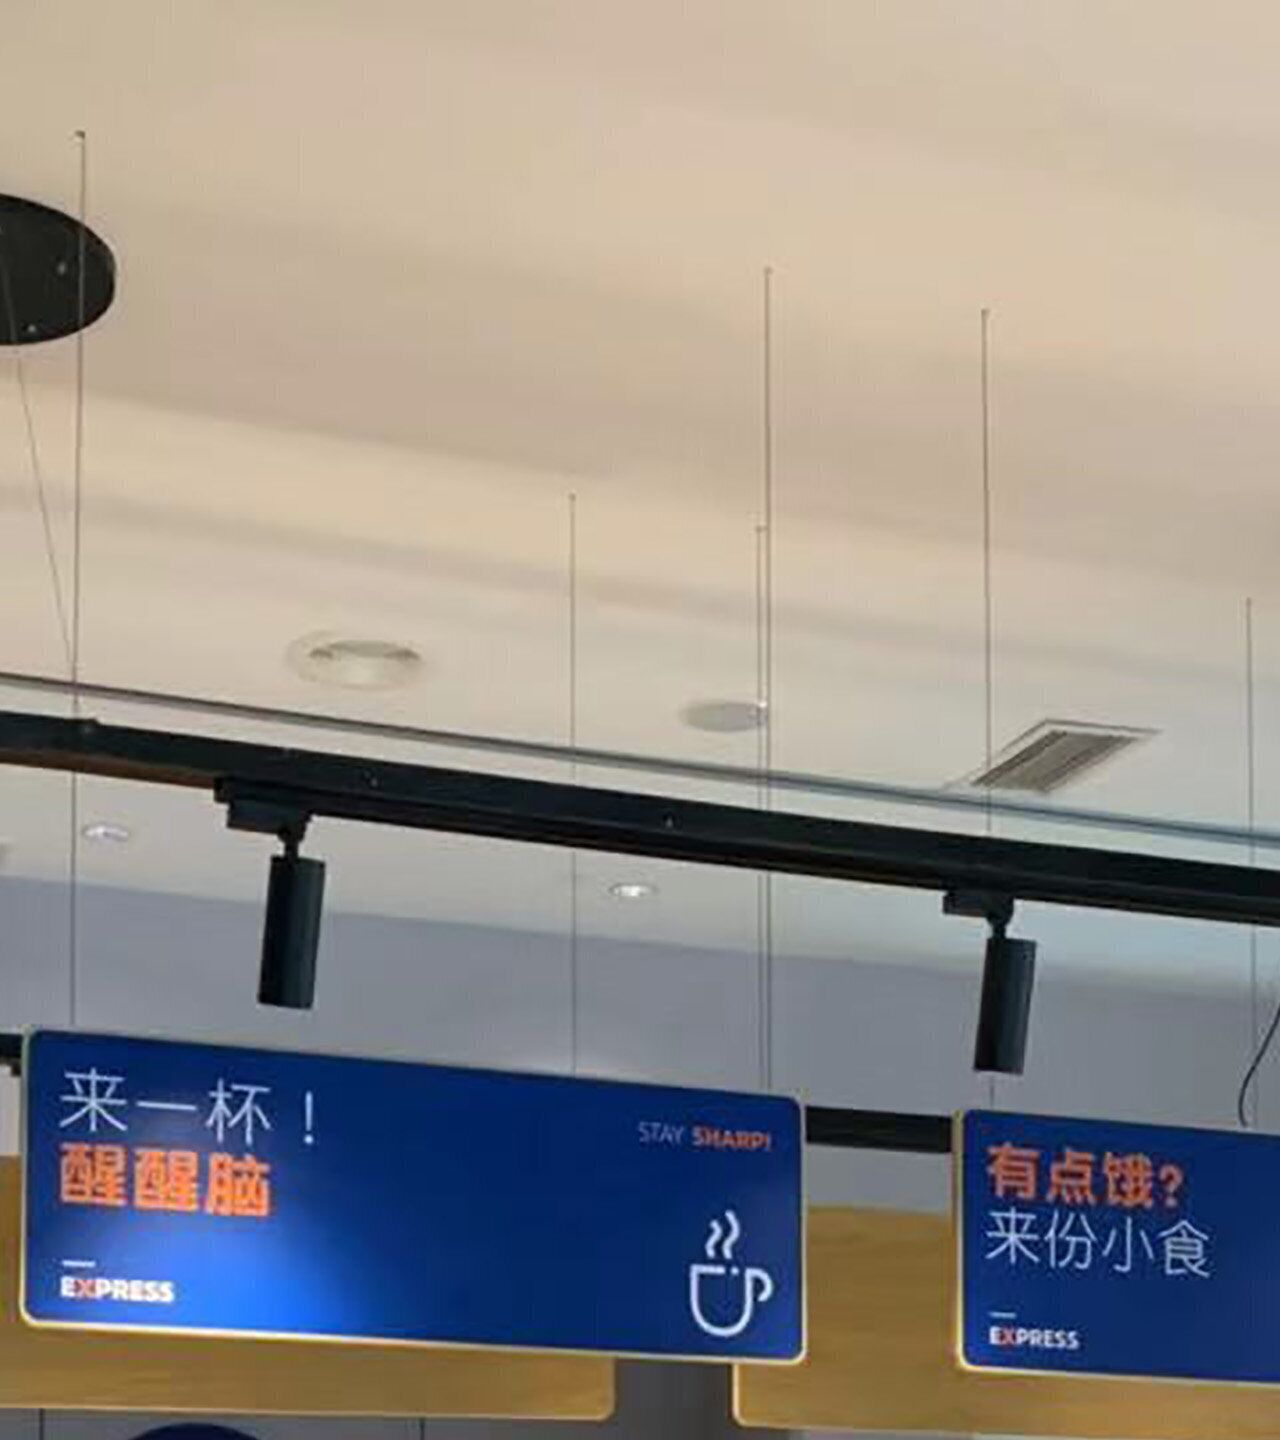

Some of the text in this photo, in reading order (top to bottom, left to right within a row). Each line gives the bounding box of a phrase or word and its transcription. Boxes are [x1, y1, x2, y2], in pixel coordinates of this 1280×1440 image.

[637, 1121, 771, 1152] STAY SHARP!
[59, 1142, 271, 1218] 醒醒脑
[986, 1141, 1184, 1210] 有点饿?
[984, 1205, 1211, 1279] 来份小食
[60, 1275, 176, 1302] EXPRESS
[988, 1325, 1080, 1350] EXPRESS
